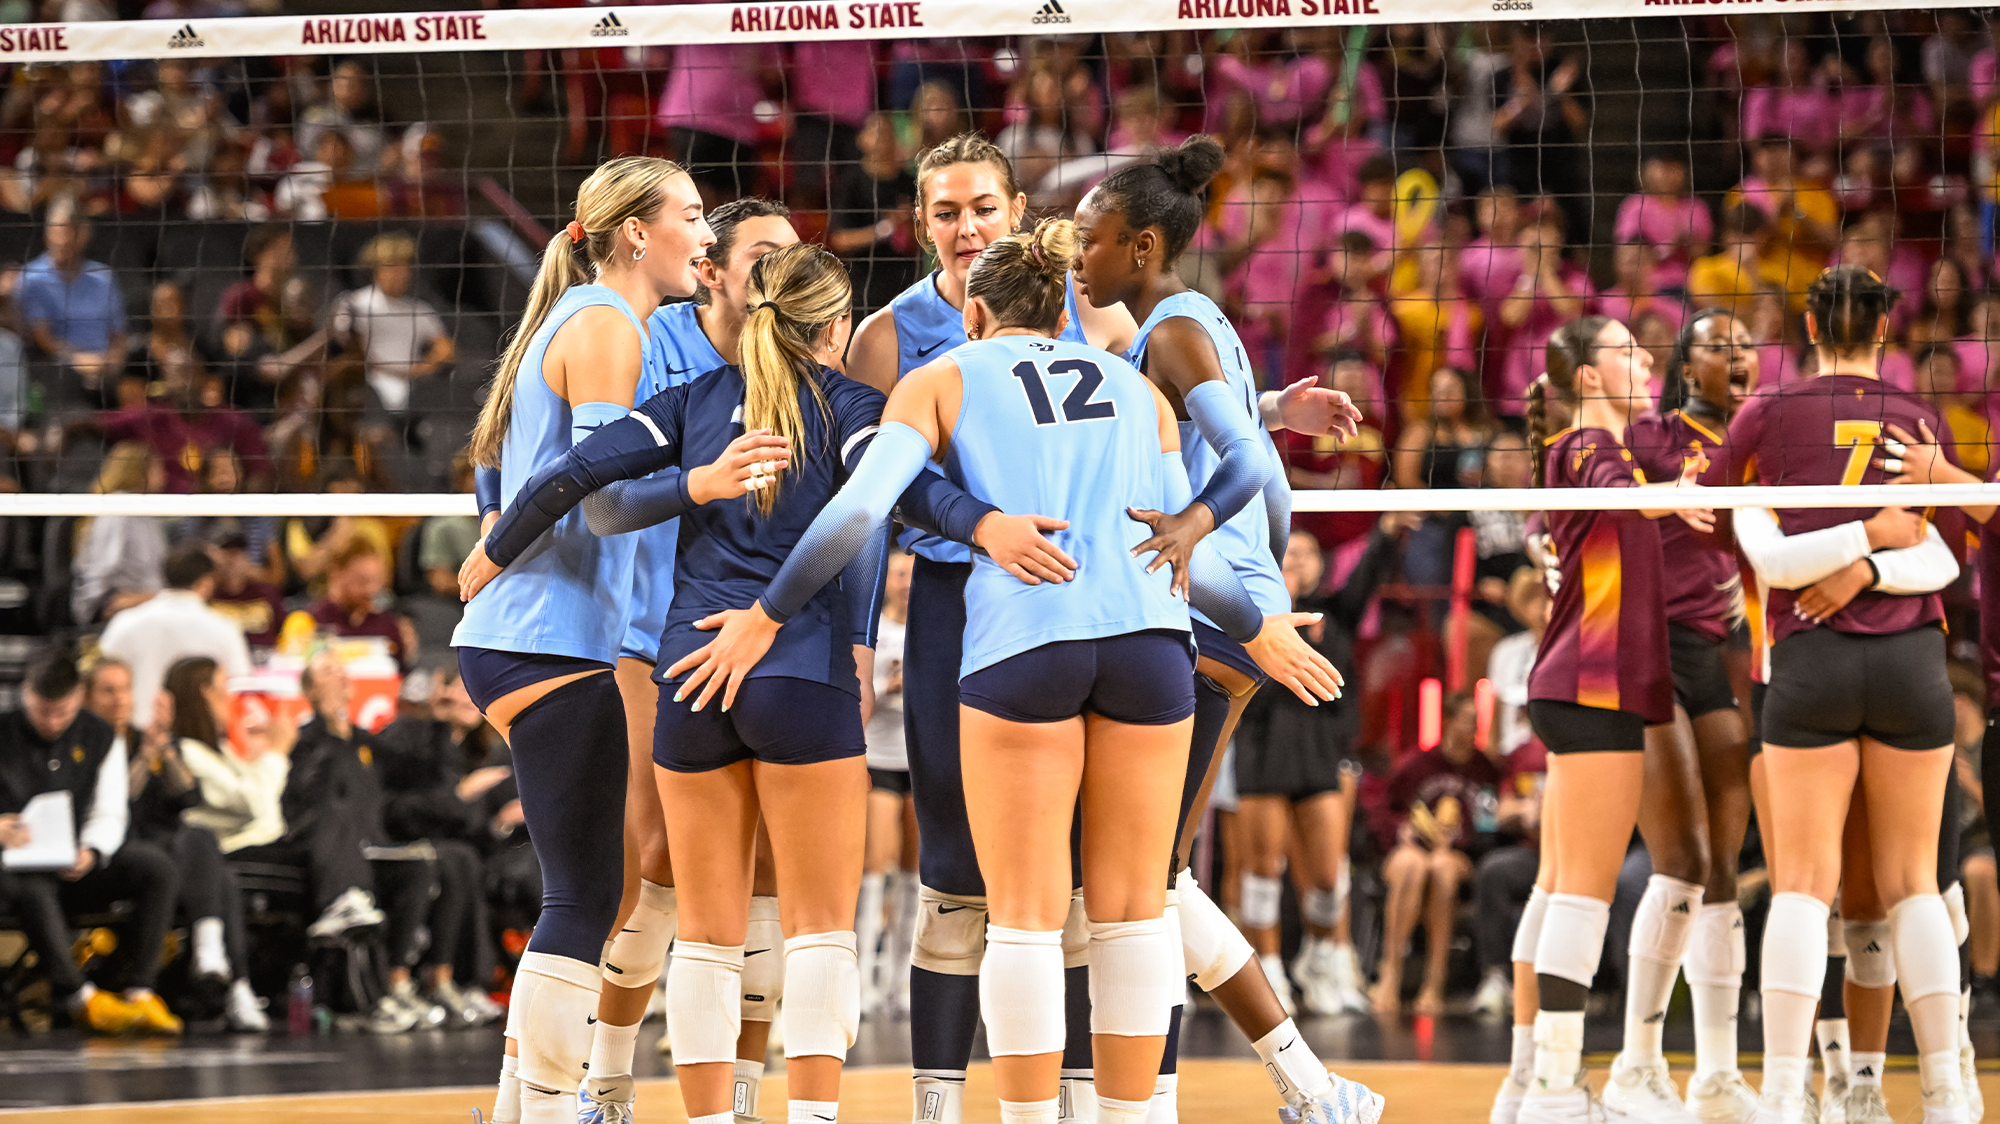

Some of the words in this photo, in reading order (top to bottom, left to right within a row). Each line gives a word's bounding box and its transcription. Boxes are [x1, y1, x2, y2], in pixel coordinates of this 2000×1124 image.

[731, 5, 839, 32] ARIZONA
[849, 2, 923, 29] STATE
[1031, 13, 1071, 24] adidas
[1178, 0, 1292, 19] ARIZONA
[0, 27, 68, 51] STATE
[302, 18, 406, 44] ARIZONA
[415, 15, 487, 41] STATE
[590, 25, 629, 37] adidas
[1009, 358, 1119, 428] 12
[1834, 420, 1884, 486] 7
